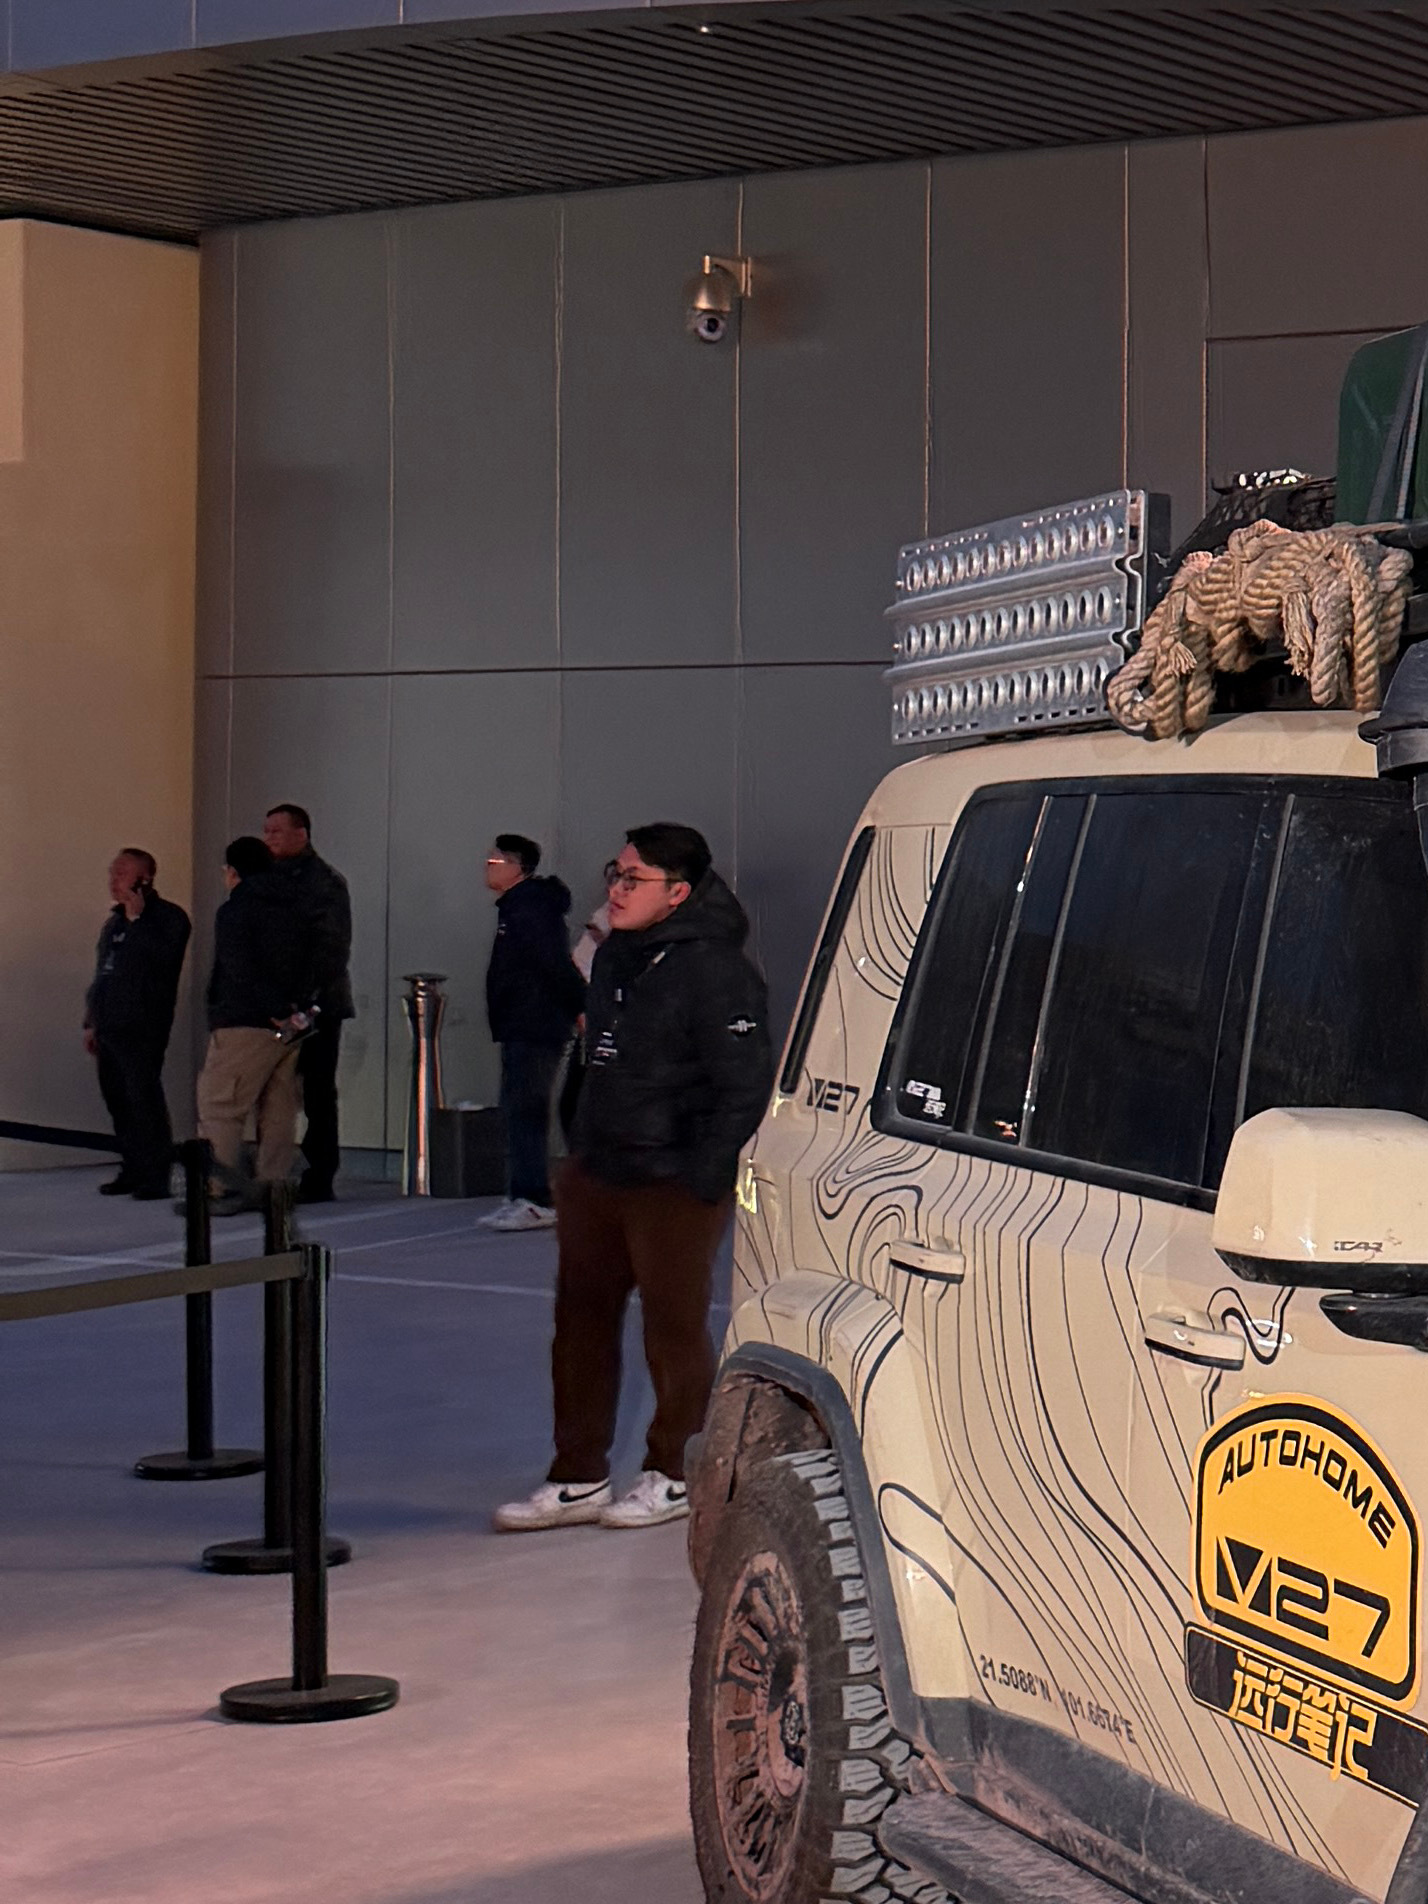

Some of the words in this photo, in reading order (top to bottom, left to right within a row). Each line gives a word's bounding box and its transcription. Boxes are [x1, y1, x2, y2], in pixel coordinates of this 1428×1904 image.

[806, 1078, 860, 1115] V27
[1218, 1429, 1396, 1549] AUTOHOME
[1216, 1536, 1391, 1659] V27
[1229, 1650, 1378, 1782] 远行笔记
